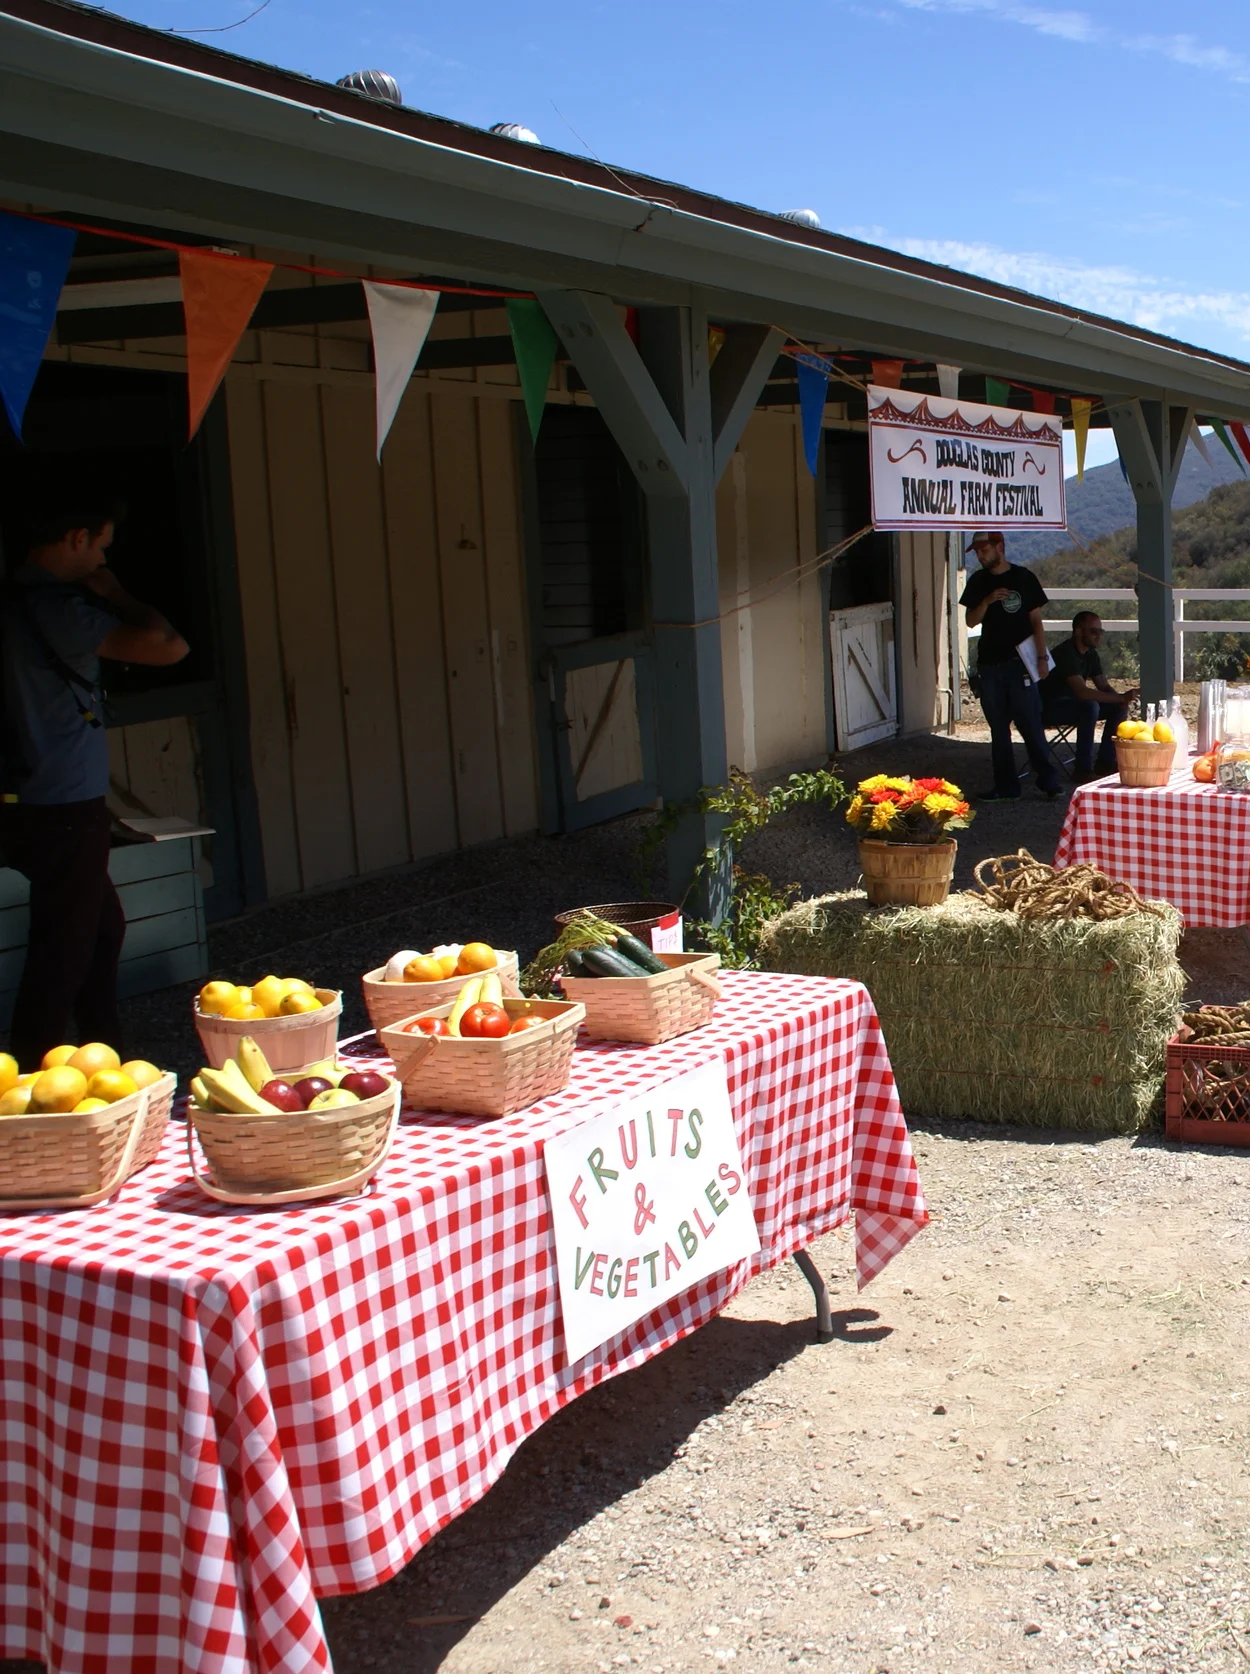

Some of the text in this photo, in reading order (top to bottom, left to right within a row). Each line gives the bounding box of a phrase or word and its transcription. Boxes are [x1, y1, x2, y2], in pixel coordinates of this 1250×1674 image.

[935, 438, 1015, 478] DOUGLAS COUNTY
[902, 477, 1043, 516] ANNUAL FARM FESTIVAL
[569, 1108, 703, 1230] FRUITS
[575, 1163, 741, 1298] VEGETABLES
[634, 1182, 656, 1235] &
